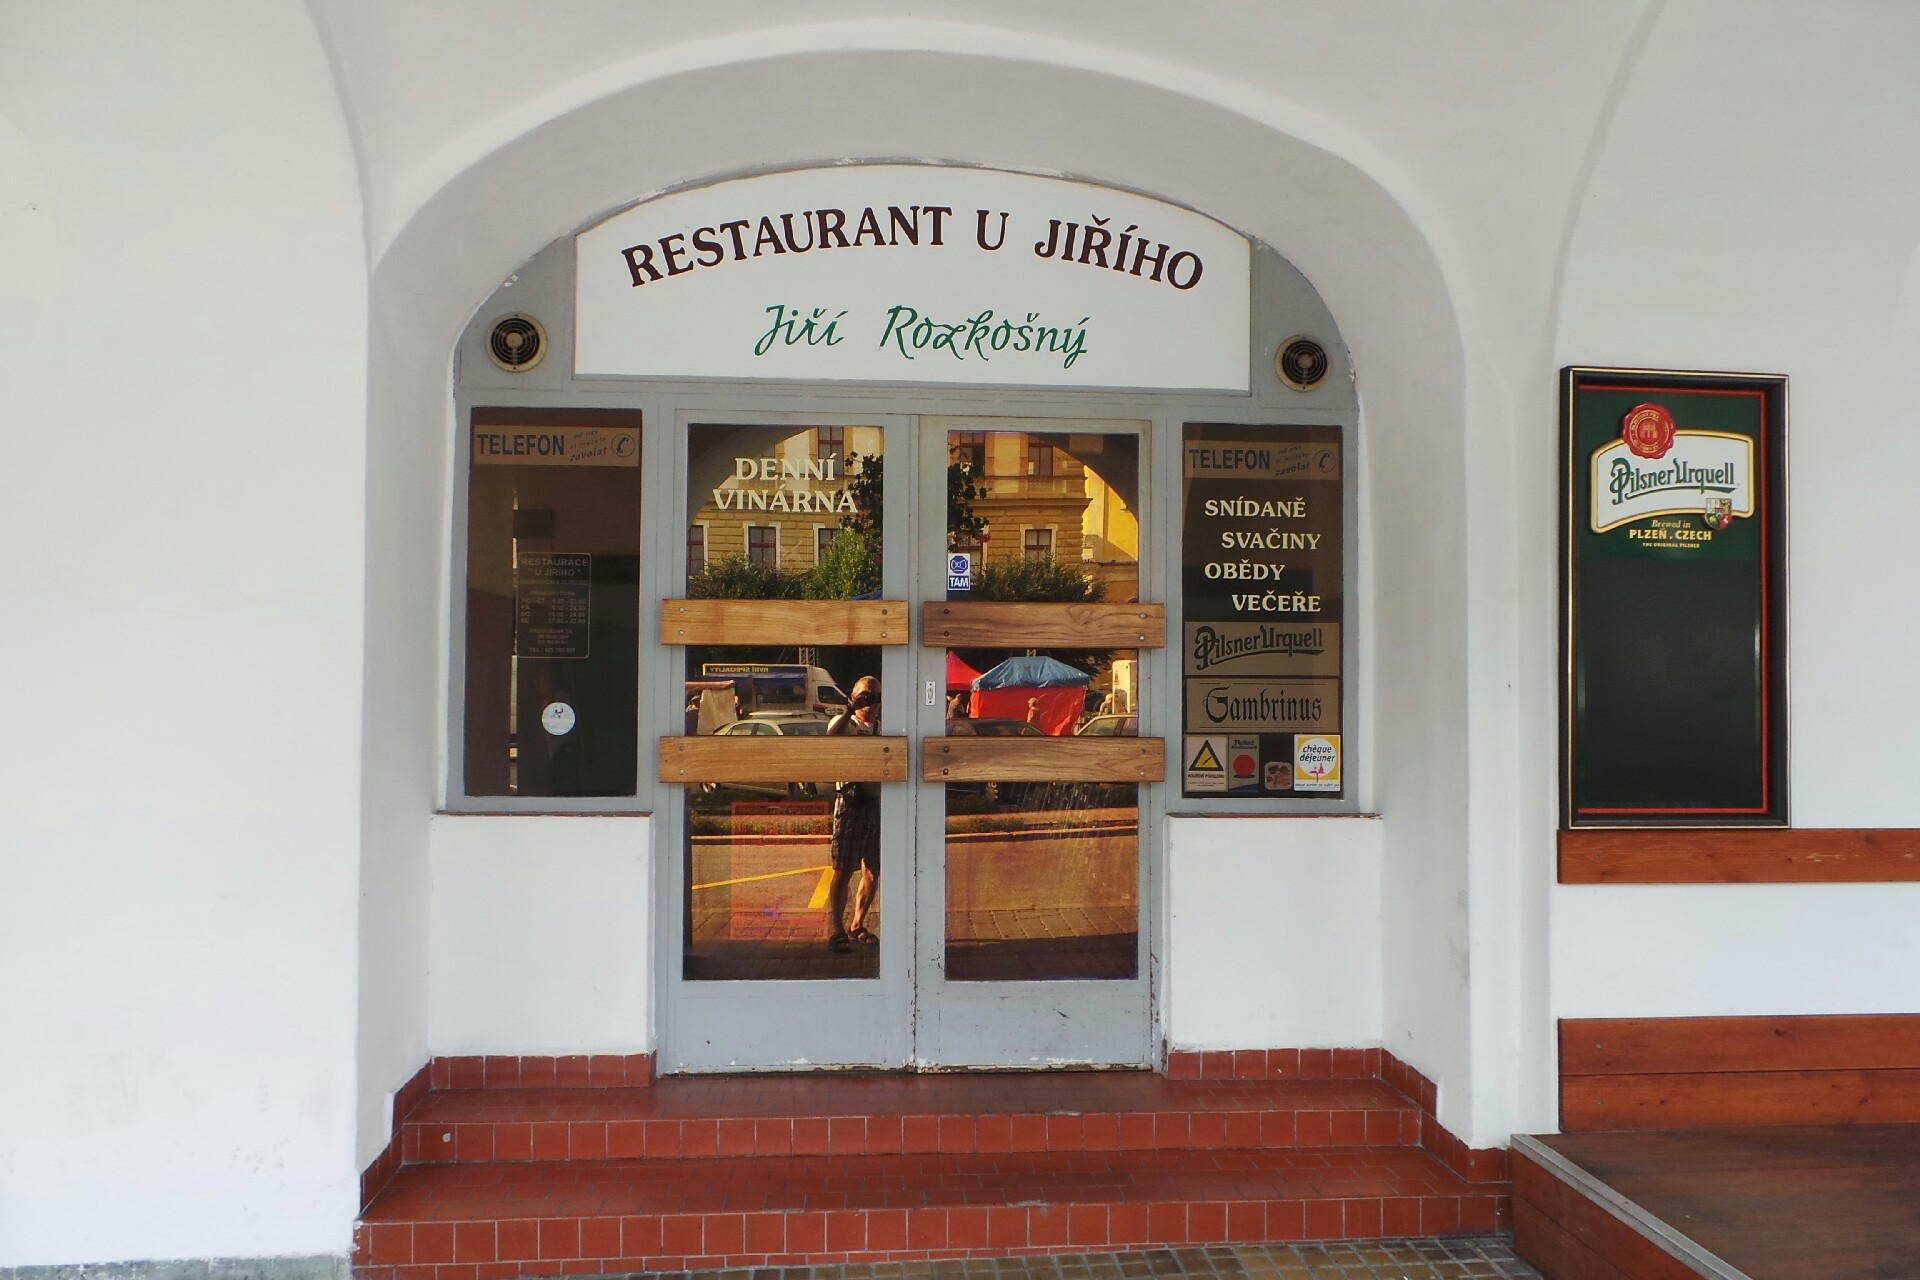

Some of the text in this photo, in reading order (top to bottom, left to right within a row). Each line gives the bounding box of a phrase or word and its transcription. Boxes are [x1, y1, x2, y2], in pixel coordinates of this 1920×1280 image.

[620, 204, 1204, 291] RESTAURANT U JIŘÍHO
[754, 304, 1091, 369] Jiří Rozkošný
[477, 434, 565, 456] TELEFON
[569, 446, 608, 462] zavolat
[735, 452, 837, 481] DENNÍ
[1188, 449, 1271, 470] TELEFON
[1275, 461, 1310, 476] zavolat
[1609, 457, 1735, 506] Pilsner Urquell
[712, 483, 859, 513] VINÁRNA
[1204, 495, 1306, 518] SNÍDANĚ
[1629, 527, 1668, 540] PLZEŇ
[1675, 529, 1713, 541] CZECH
[1651, 519, 1691, 529] Brewed in
[1221, 527, 1322, 550] SVAČINY
[1204, 558, 1286, 581] OBĚDY
[949, 577, 969, 588] TAM
[1231, 589, 1321, 612] VEČEŘE
[1193, 624, 1323, 671] Pilsner Urquell
[1202, 685, 1322, 723] Gambrinus
[1299, 753, 1335, 764] déjeuner
[1302, 744, 1332, 755] chèque
